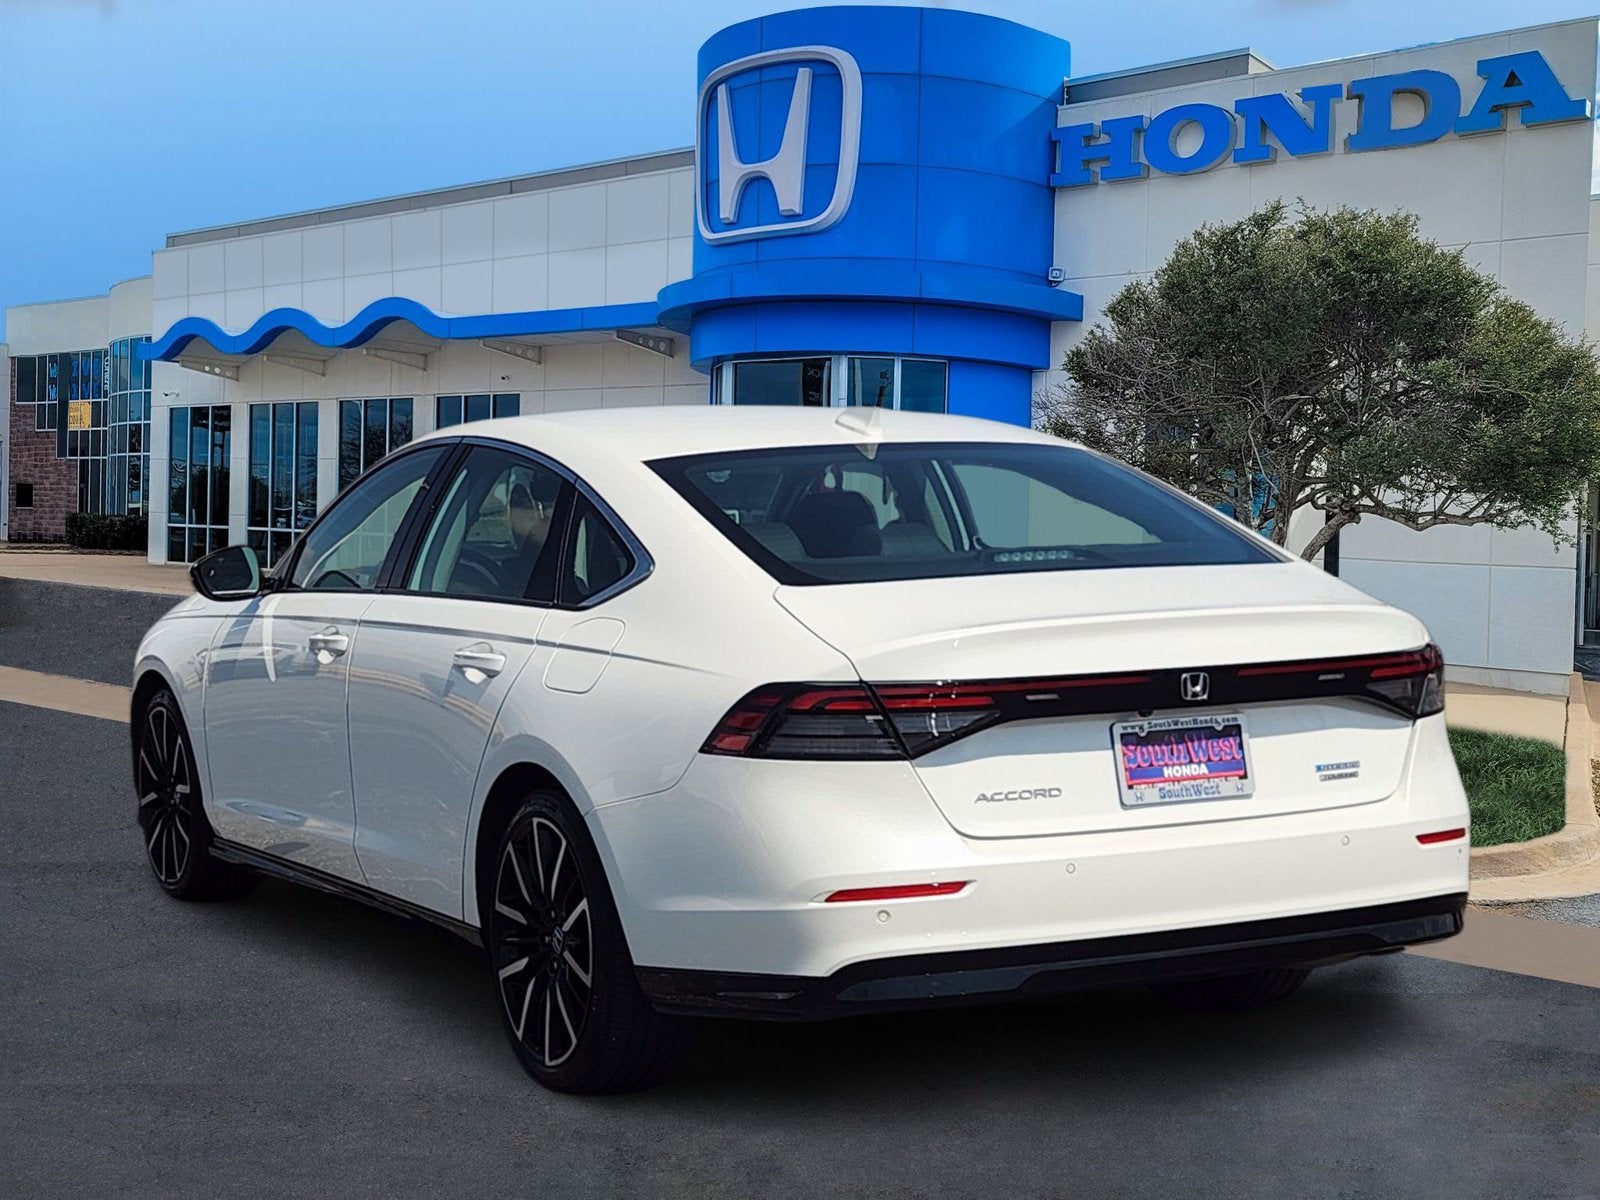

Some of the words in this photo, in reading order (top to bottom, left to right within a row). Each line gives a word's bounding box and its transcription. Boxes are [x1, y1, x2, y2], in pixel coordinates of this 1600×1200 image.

[1050, 50, 1591, 188] HONDA
[1163, 763, 1209, 778] HONDA
[974, 787, 1062, 804] ACCORD
